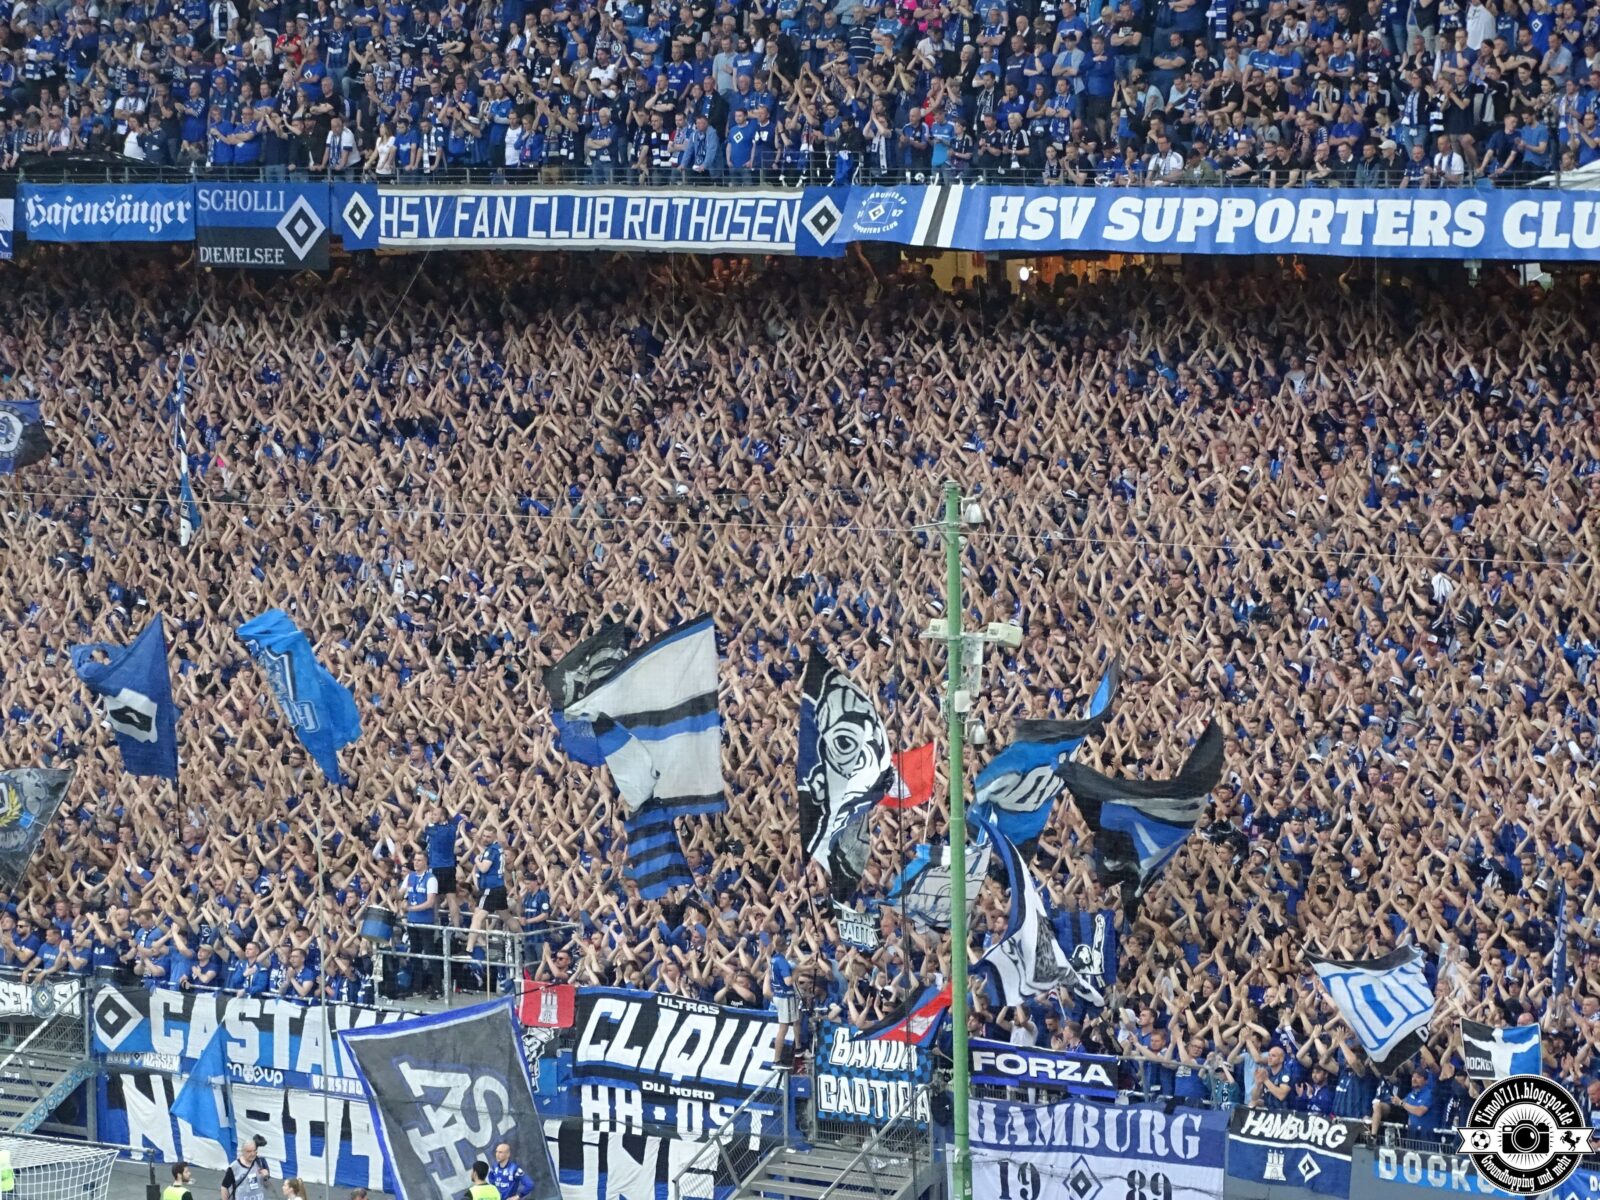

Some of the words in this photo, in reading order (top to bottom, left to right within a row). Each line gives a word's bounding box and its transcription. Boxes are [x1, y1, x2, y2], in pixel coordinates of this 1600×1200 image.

[198, 189, 285, 212] SCHOLLI
[380, 196, 444, 238] HSV
[453, 196, 517, 238] FAN
[527, 196, 615, 239] CLUB
[623, 197, 802, 242] ROTHOSEN
[984, 195, 1096, 241] HSV
[1102, 196, 1488, 248] SUPPORTERS
[199, 246, 285, 265] DIEMELSEE
[657, 996, 720, 1015] ULTRAS
[577, 998, 794, 1089] CLIQUE
[972, 1051, 1113, 1086] FORZA
[642, 1081, 665, 1093] DU
[669, 1086, 715, 1100] NORD
[968, 1100, 1202, 1159] HAMBURG
[1240, 1112, 1348, 1149] HAMBURG
[999, 1161, 1041, 1200] 19
[1126, 1169, 1172, 1200] 89
